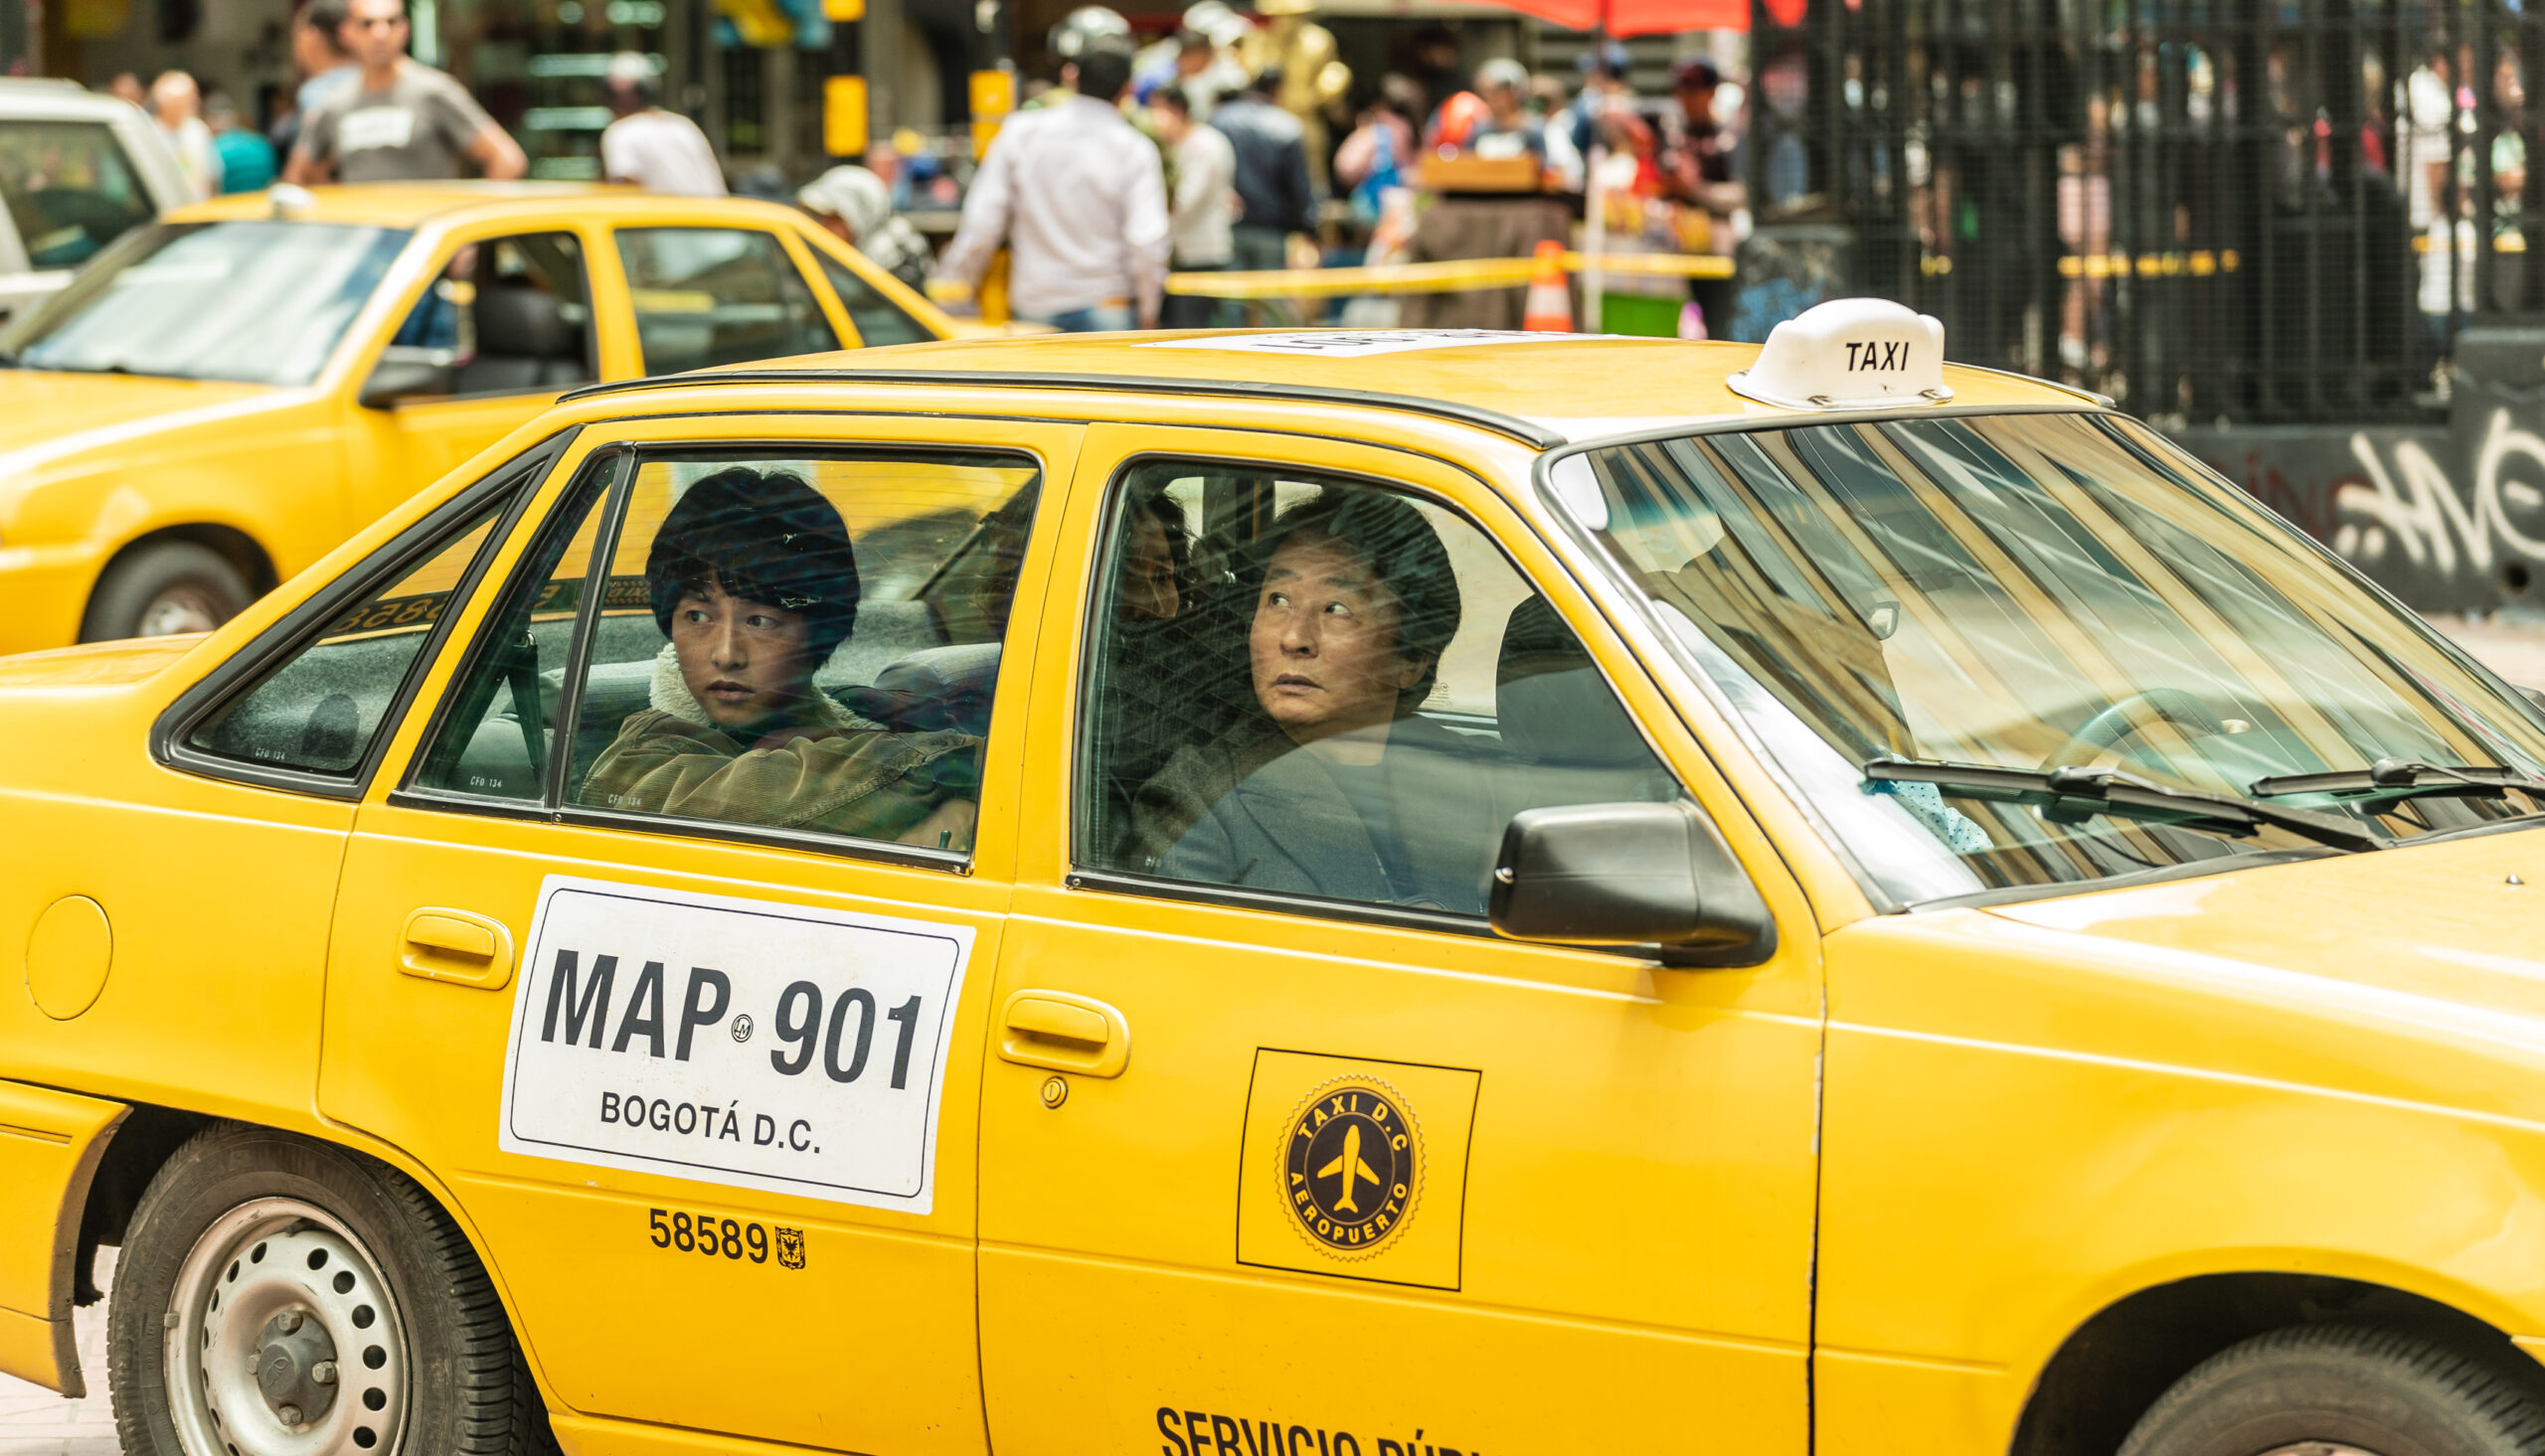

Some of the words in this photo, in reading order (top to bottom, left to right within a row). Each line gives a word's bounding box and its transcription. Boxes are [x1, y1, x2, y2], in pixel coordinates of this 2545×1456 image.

[1845, 341, 1910, 372] TAXI
[489, 778, 503, 788] 134
[541, 948, 733, 1062] MAP
[769, 979, 924, 1090] 901
[600, 1091, 742, 1142] BOGOTÁ
[754, 1113, 821, 1154] D.C.
[1297, 1094, 1357, 1139] TAXI
[1371, 1102, 1408, 1152] D.C
[649, 1208, 768, 1264] 58589
[1290, 1172, 1408, 1243] AEROPUERTO
